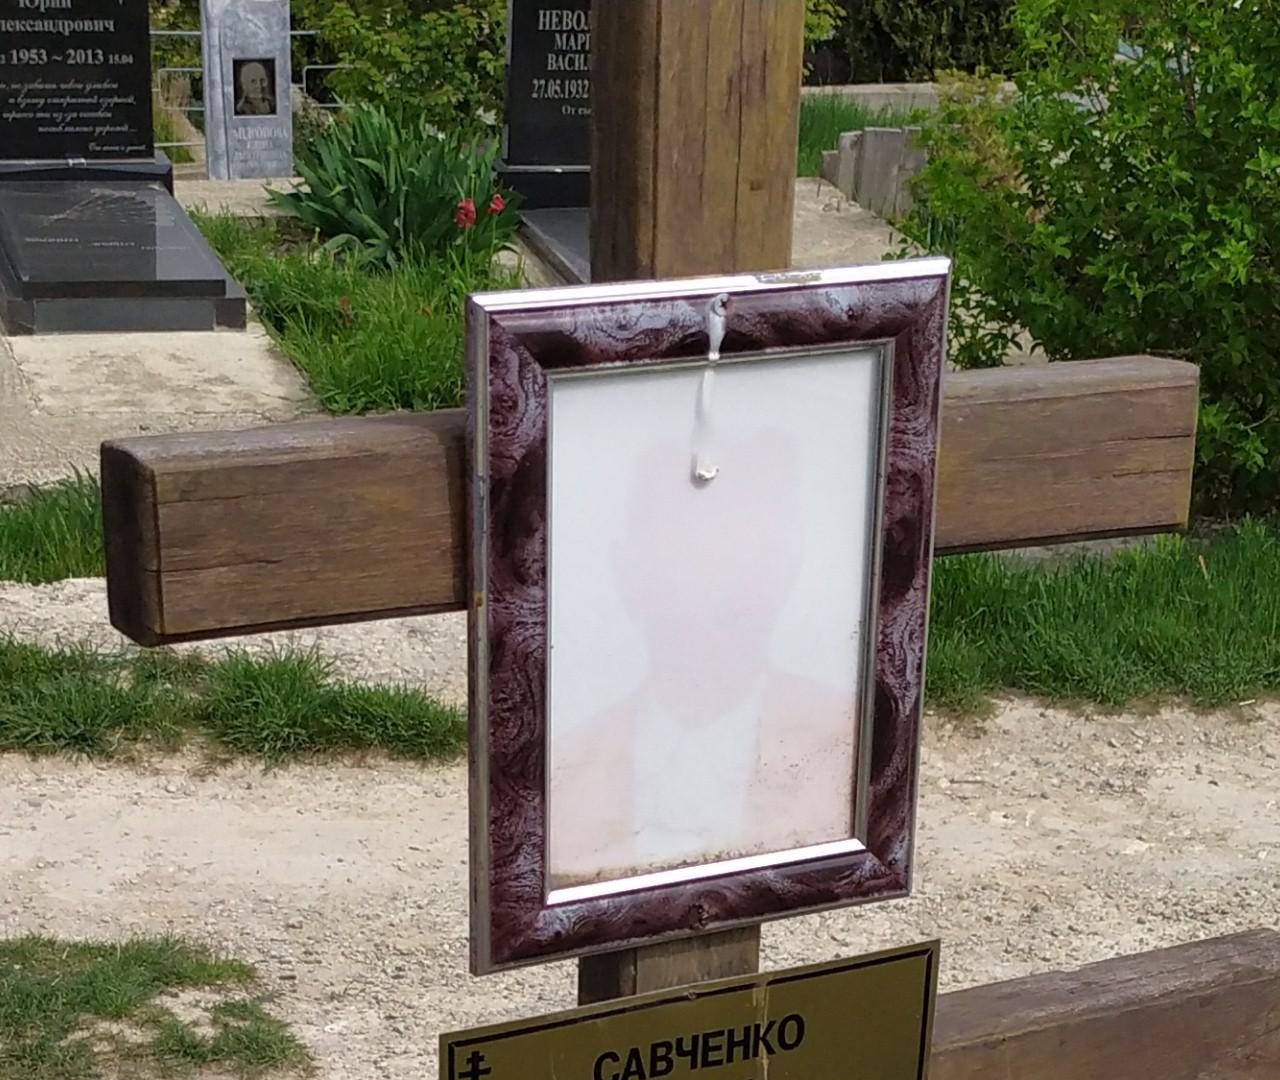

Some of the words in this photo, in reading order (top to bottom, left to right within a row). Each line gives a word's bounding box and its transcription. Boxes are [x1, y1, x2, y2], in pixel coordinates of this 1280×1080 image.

[9, 48, 48, 65] 1953
[65, 48, 104, 65] 2013
[531, 78, 589, 99] 27.05.1932
